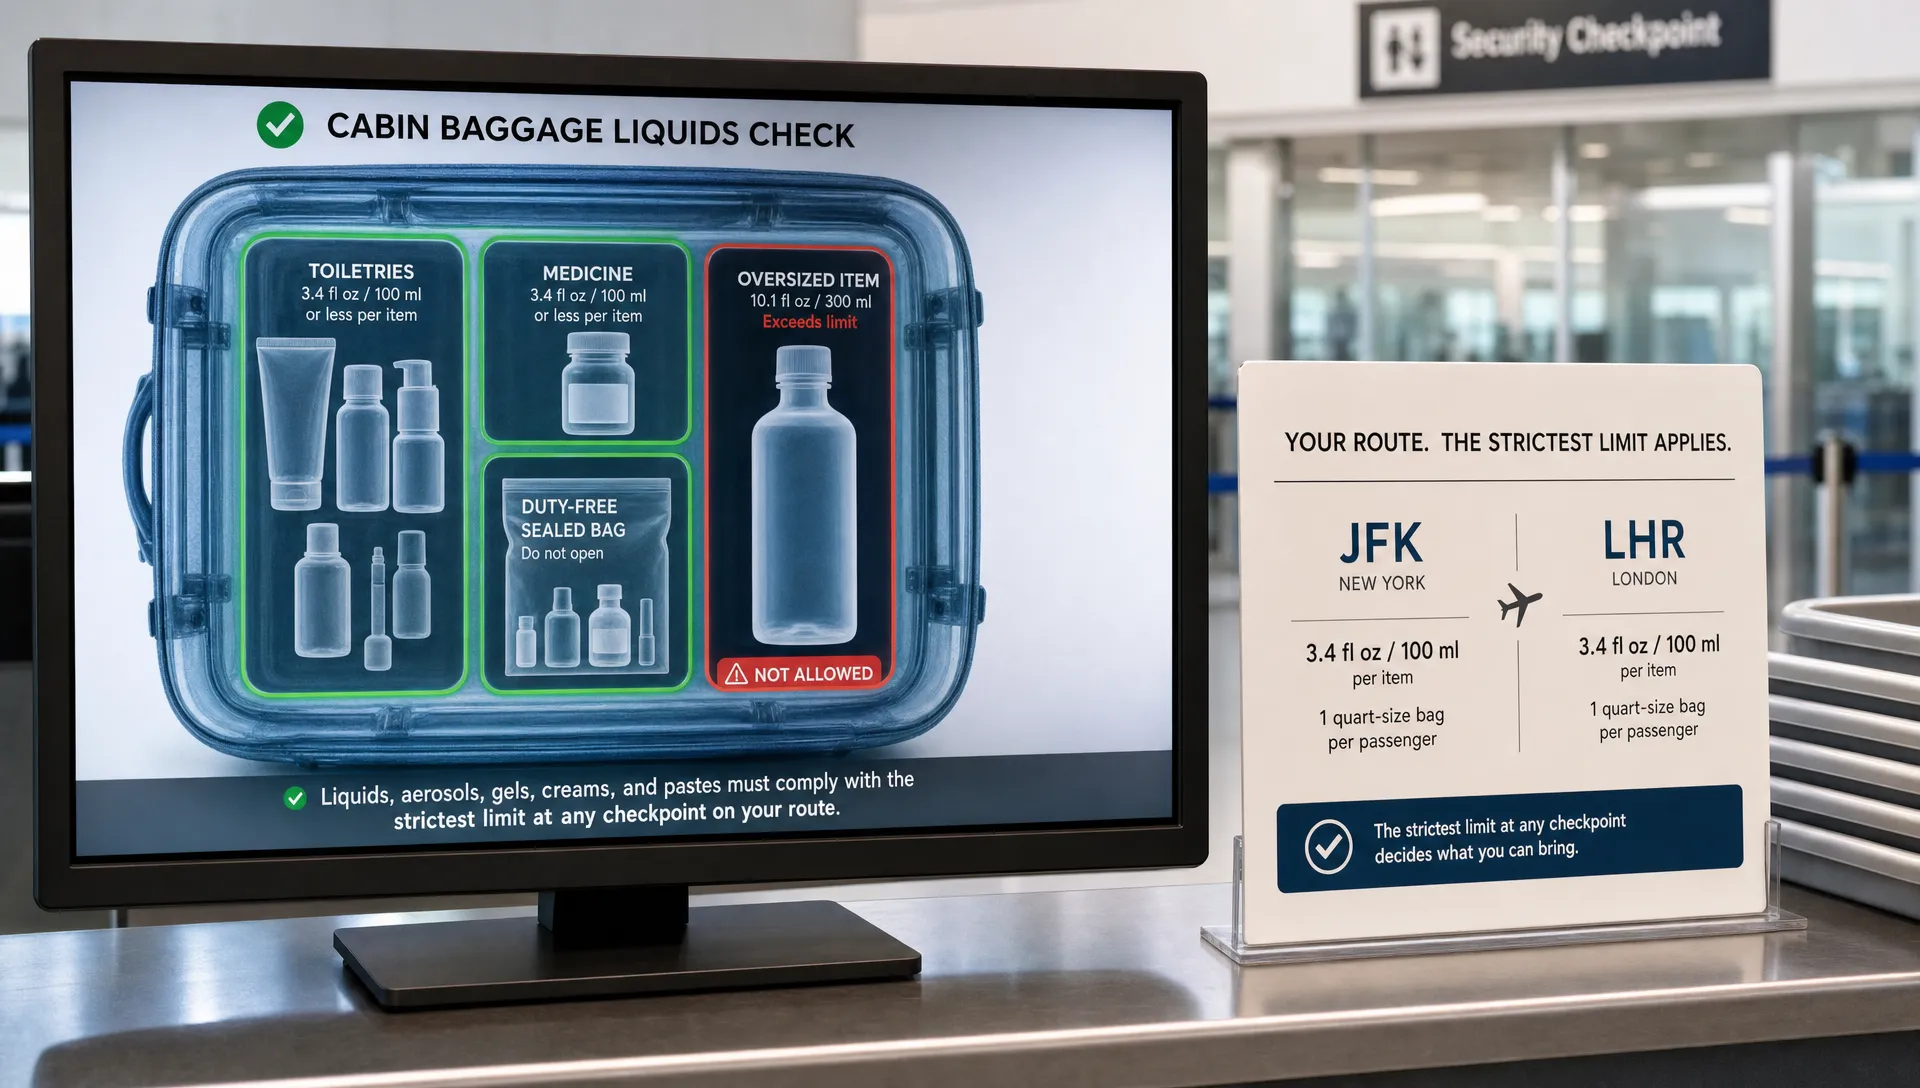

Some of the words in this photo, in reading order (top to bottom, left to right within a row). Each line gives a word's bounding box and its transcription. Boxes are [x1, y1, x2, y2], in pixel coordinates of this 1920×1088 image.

[1451, 18, 1563, 62] Security
[1566, 11, 1722, 57] Checkpoint
[328, 112, 428, 140] CABIN
[441, 115, 603, 143] BAGGAGE
[614, 119, 739, 146] LIQUIDS
[749, 121, 855, 148] CHECK
[308, 263, 414, 279] TOILETRIES
[544, 266, 633, 281] MEDICINE
[738, 271, 835, 287] OVERSIZED
[840, 273, 879, 288] ITEM
[302, 286, 324, 300] 3.4
[328, 286, 337, 300] fl
[343, 290, 359, 300] oz
[364, 286, 370, 302] /
[375, 287, 400, 301] 100
[405, 287, 421, 301] ml
[531, 288, 552, 301] 3.4
[556, 288, 565, 302] fl
[570, 292, 586, 302] oz
[590, 288, 597, 304] /
[601, 289, 625, 302] 100
[630, 289, 646, 302] ml
[751, 293, 775, 307] 10.1
[781, 293, 790, 307] fl
[795, 297, 810, 307] oz
[814, 294, 821, 309] /
[825, 294, 851, 308] 300
[856, 294, 871, 308] ml
[306, 310, 321, 321] or
[326, 306, 352, 321] less
[358, 311, 382, 325] per
[386, 307, 417, 321] item
[534, 311, 549, 322] or
[554, 308, 580, 322] less
[585, 312, 608, 326] per
[613, 309, 642, 322] item
[763, 314, 822, 329] Exceeds
[827, 314, 857, 329] limit
[1285, 432, 1346, 452] YOUR
[1354, 432, 1429, 452] ROUTE.
[1441, 432, 1481, 452] THE
[1489, 432, 1593, 452] STRICTEST
[1600, 433, 1648, 451] LIMIT
[1654, 433, 1731, 451] APPLIES.
[522, 499, 617, 514] DUTY-FREE
[521, 522, 585, 538] SEALED
[591, 522, 625, 537] BAG
[1605, 519, 1685, 559] LHR
[1340, 522, 1423, 564] JFK
[521, 546, 540, 560] Do
[545, 547, 566, 560] not
[570, 549, 603, 563] open
[1340, 576, 1377, 591] NEW
[1382, 575, 1425, 590] YORK
[1613, 571, 1677, 586] LONDON
[1306, 643, 1336, 662] 3.4
[1342, 642, 1354, 661] fl
[1360, 647, 1381, 661] oz
[1387, 641, 1395, 662] /
[1401, 641, 1433, 660] 100
[1439, 640, 1458, 659] ml
[1579, 637, 1607, 655] 3.4
[1612, 636, 1623, 655] fl
[1629, 641, 1648, 654] oz
[1653, 635, 1661, 655] /
[1667, 634, 1696, 653] 100
[1702, 634, 1719, 652] ml
[755, 667, 790, 682] NOT
[794, 666, 873, 682] ALLOWED
[1353, 674, 1377, 690] per
[1382, 670, 1413, 685] item
[1621, 667, 1643, 682] per
[1647, 662, 1676, 677] item
[1320, 710, 1326, 725] 1
[1333, 707, 1410, 729] quart-size
[1417, 706, 1444, 726] bag
[1590, 701, 1596, 716] 1
[1602, 699, 1674, 720] quart-size
[1680, 698, 1705, 716] bag
[1600, 728, 1623, 743] per
[1628, 725, 1698, 742] passenger
[1329, 738, 1354, 754] per
[1360, 734, 1437, 753] passenger
[322, 785, 394, 810] Liquids,
[401, 782, 484, 804] aerosols,
[492, 781, 535, 805] gels,
[542, 784, 615, 799] creams,
[623, 777, 657, 796] and
[665, 778, 721, 799] pastes
[728, 776, 770, 792] must
[776, 771, 838, 795] comply
[844, 771, 881, 789] with
[887, 769, 914, 787] the
[394, 810, 475, 830] strictest
[484, 807, 526, 827] limit
[533, 809, 553, 825] at
[561, 810, 596, 828] any
[603, 802, 706, 826] checkpoint
[713, 806, 735, 819] on
[741, 804, 782, 823] your
[789, 800, 840, 817] route.
[1374, 822, 1401, 839] The
[1406, 821, 1461, 837] strictest
[1466, 818, 1496, 834] limit
[1500, 819, 1515, 833] at
[1519, 820, 1545, 836] any
[1549, 812, 1626, 833] checkpoint
[1375, 846, 1432, 864] decides
[1437, 844, 1474, 861] what
[1478, 846, 1504, 863] you
[1509, 845, 1533, 857] can
[1539, 840, 1578, 858] bring.
